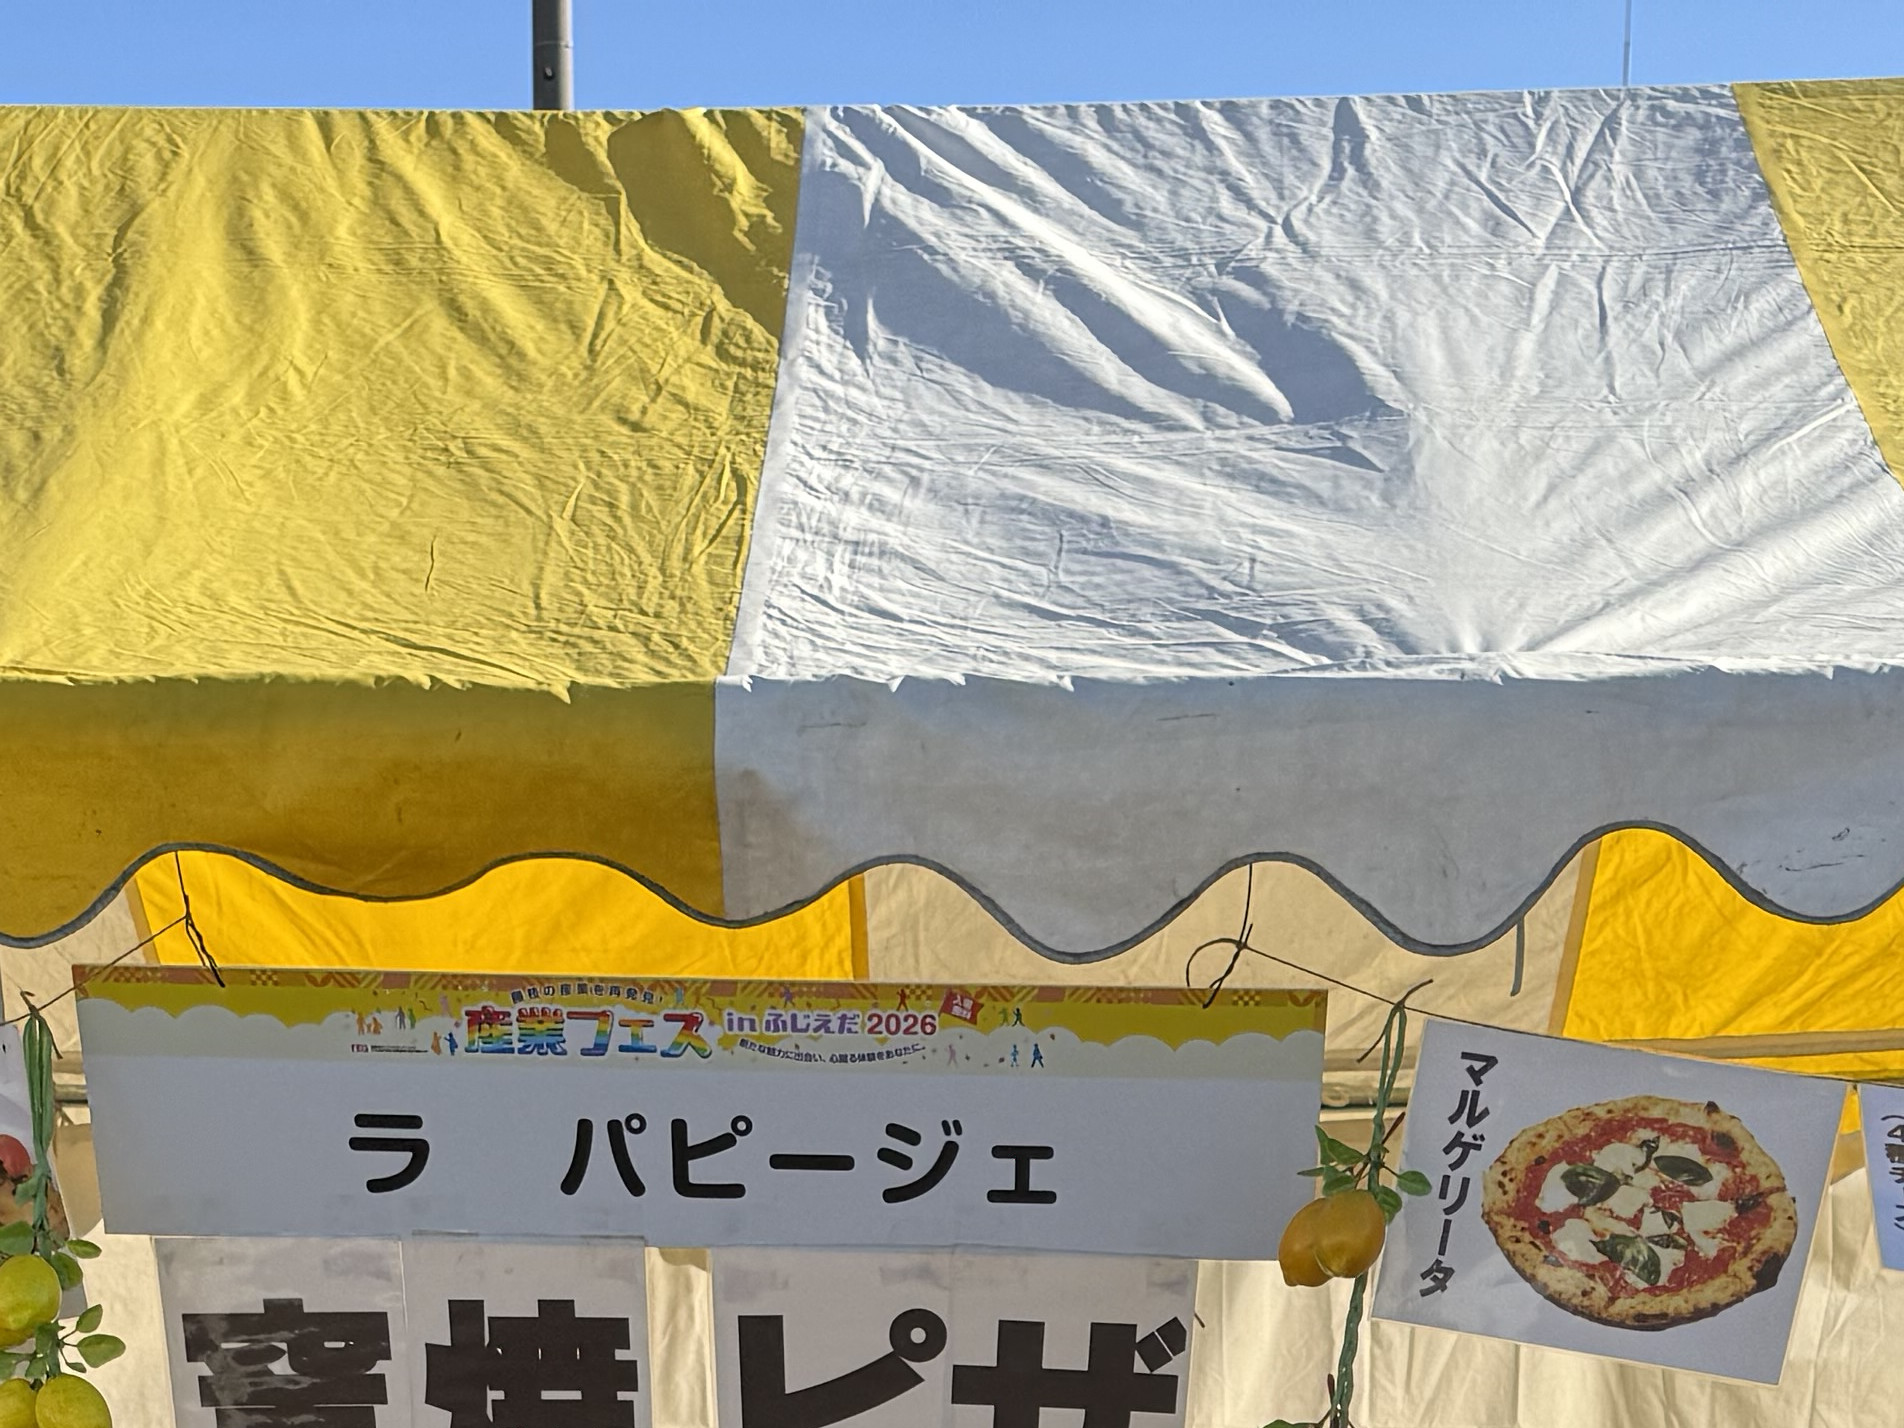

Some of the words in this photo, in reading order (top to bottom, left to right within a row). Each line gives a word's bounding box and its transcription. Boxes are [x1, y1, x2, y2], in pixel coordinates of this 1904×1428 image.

[464, 1005, 713, 1059] 産業フェス
[866, 1013, 937, 1036] 2026
[349, 1112, 430, 1195] ラ
[559, 1112, 1058, 1207] パピージェ
[1418, 1050, 1499, 1298] マルゲリータ
